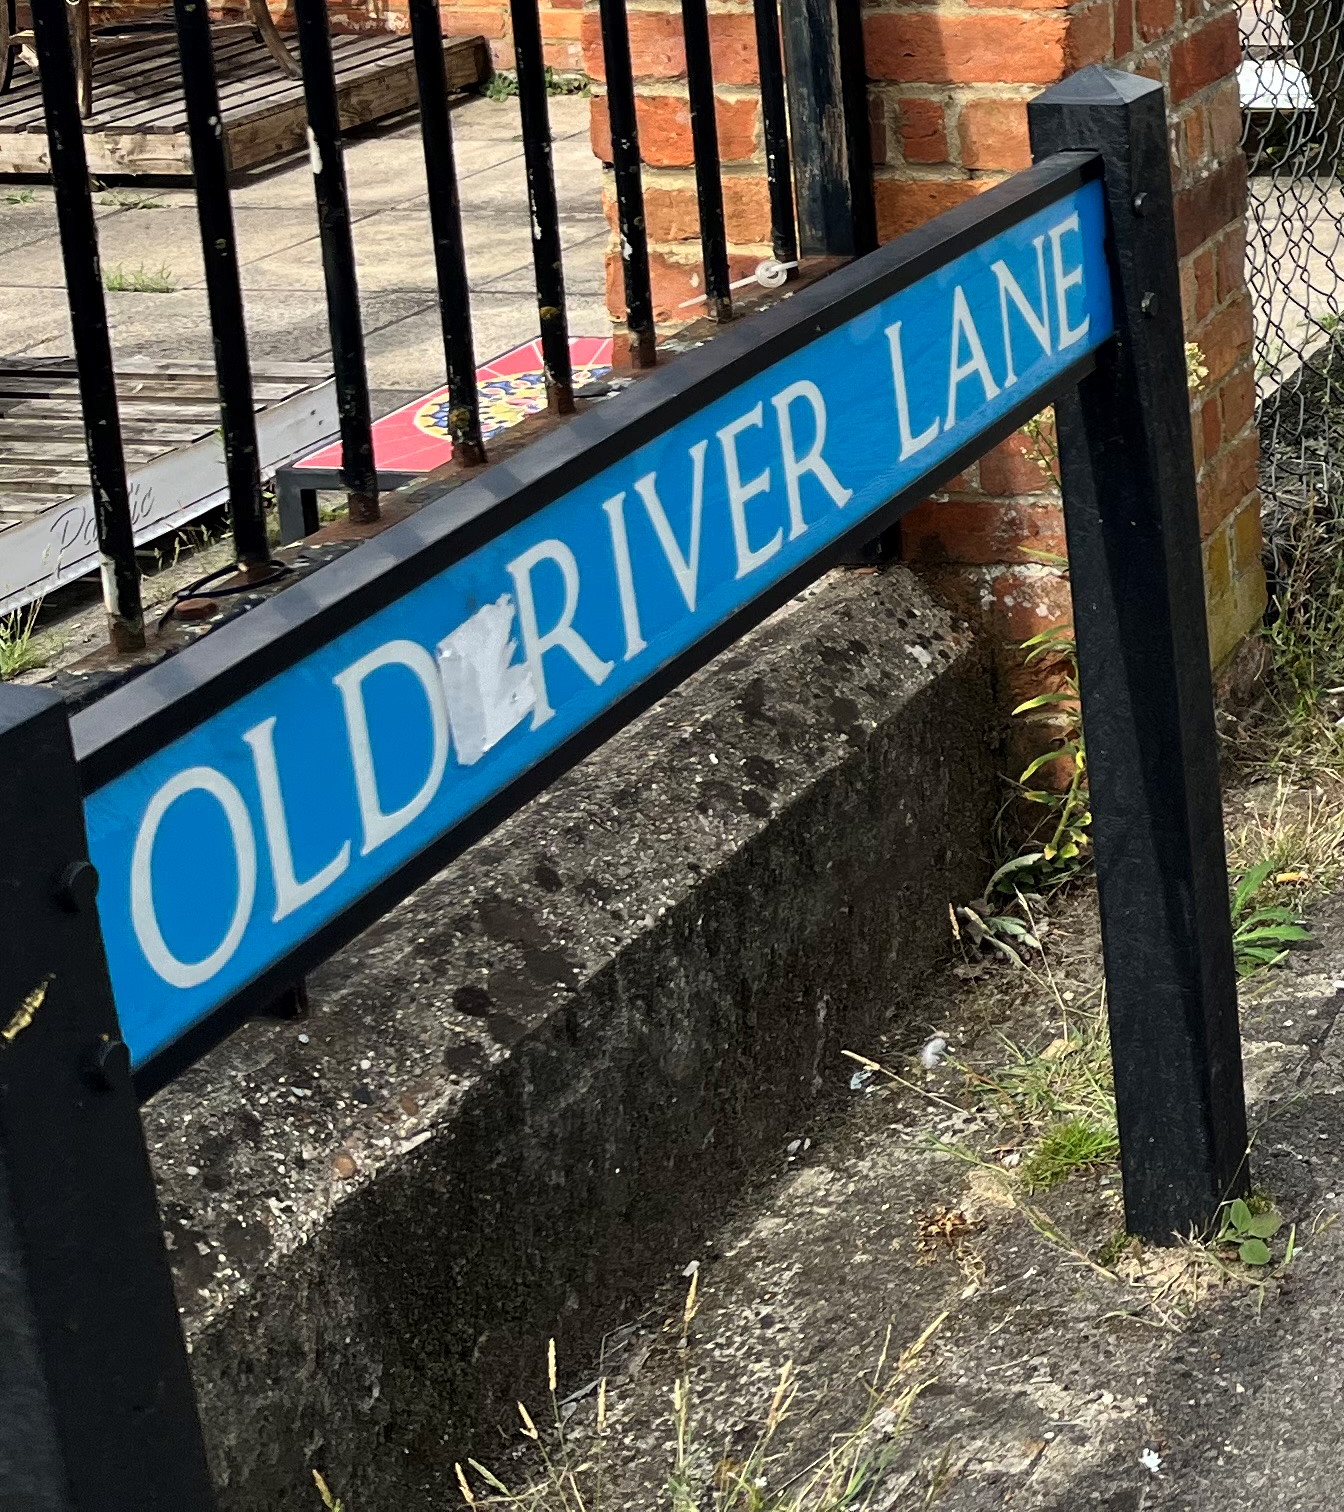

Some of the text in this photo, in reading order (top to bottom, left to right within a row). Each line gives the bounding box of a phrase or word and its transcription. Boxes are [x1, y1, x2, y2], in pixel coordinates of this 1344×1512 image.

[129, 214, 1092, 989] OLD RIVER LANE
